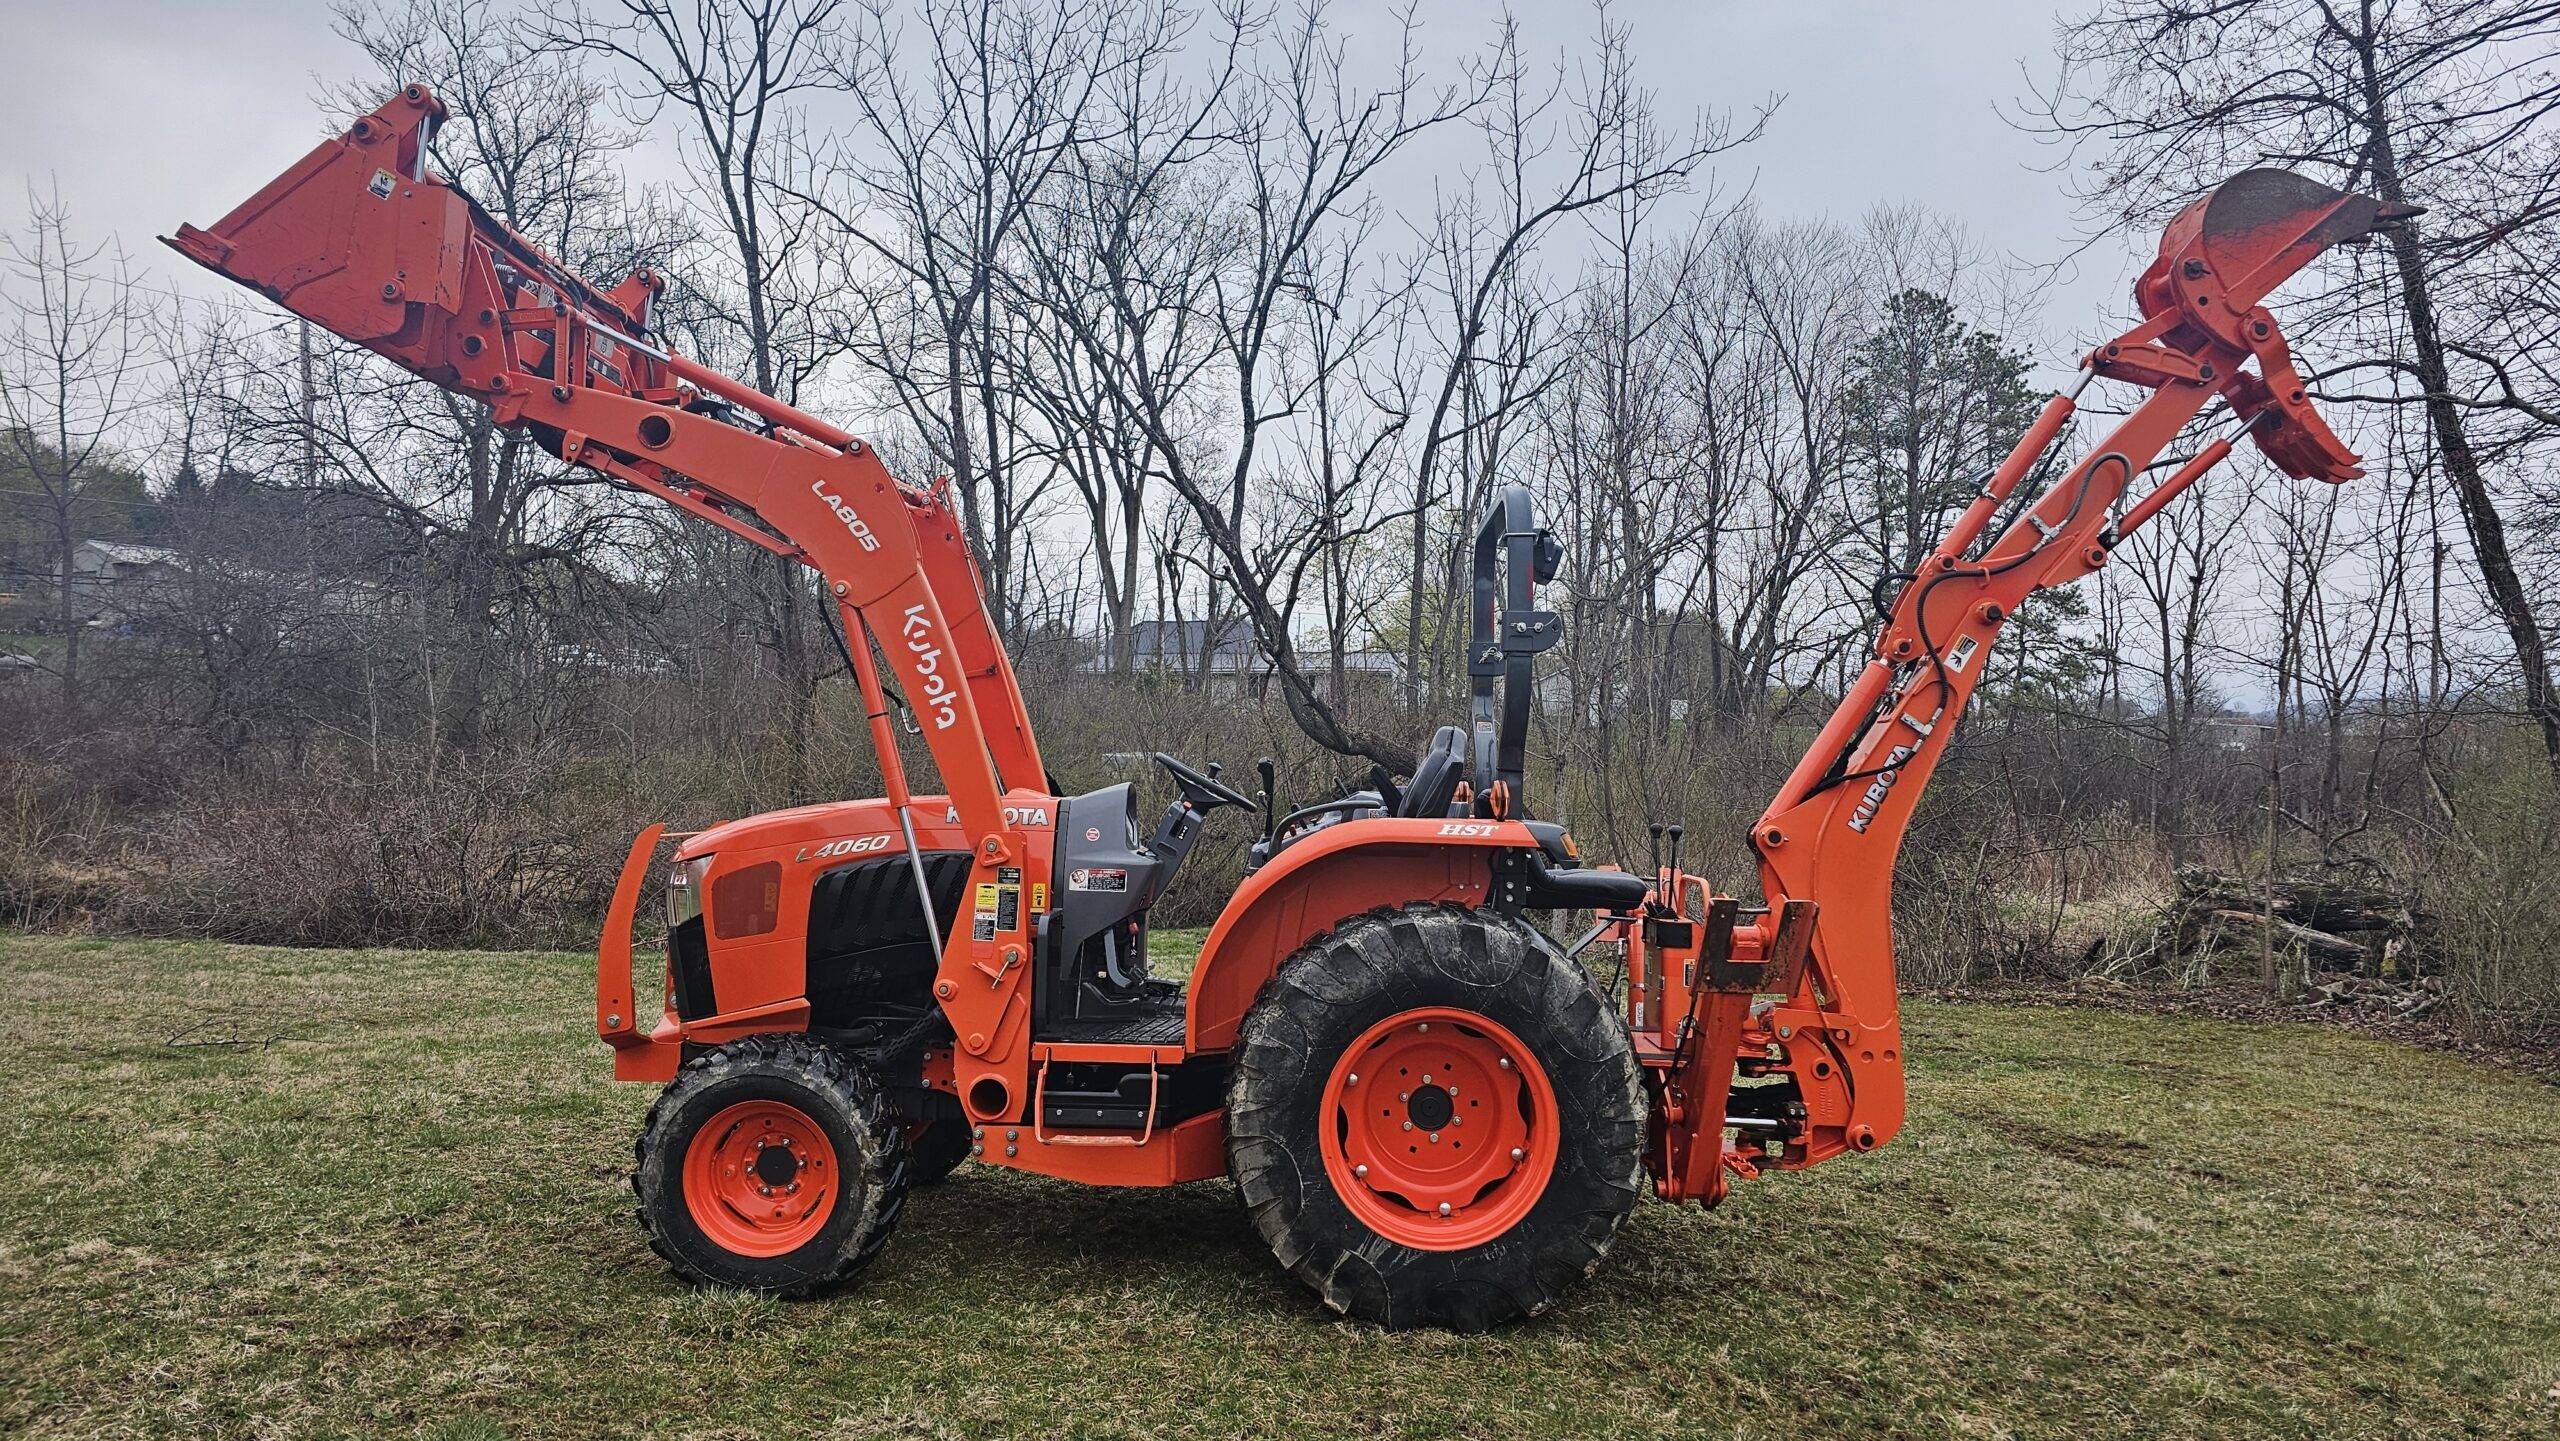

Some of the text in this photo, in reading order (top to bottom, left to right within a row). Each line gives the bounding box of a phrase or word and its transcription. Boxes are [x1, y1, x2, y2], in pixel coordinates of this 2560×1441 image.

[811, 479, 881, 552] LA805
[903, 604, 957, 730] Kubota
[946, 806, 1049, 826] KOTA
[1437, 823, 1499, 837] HST
